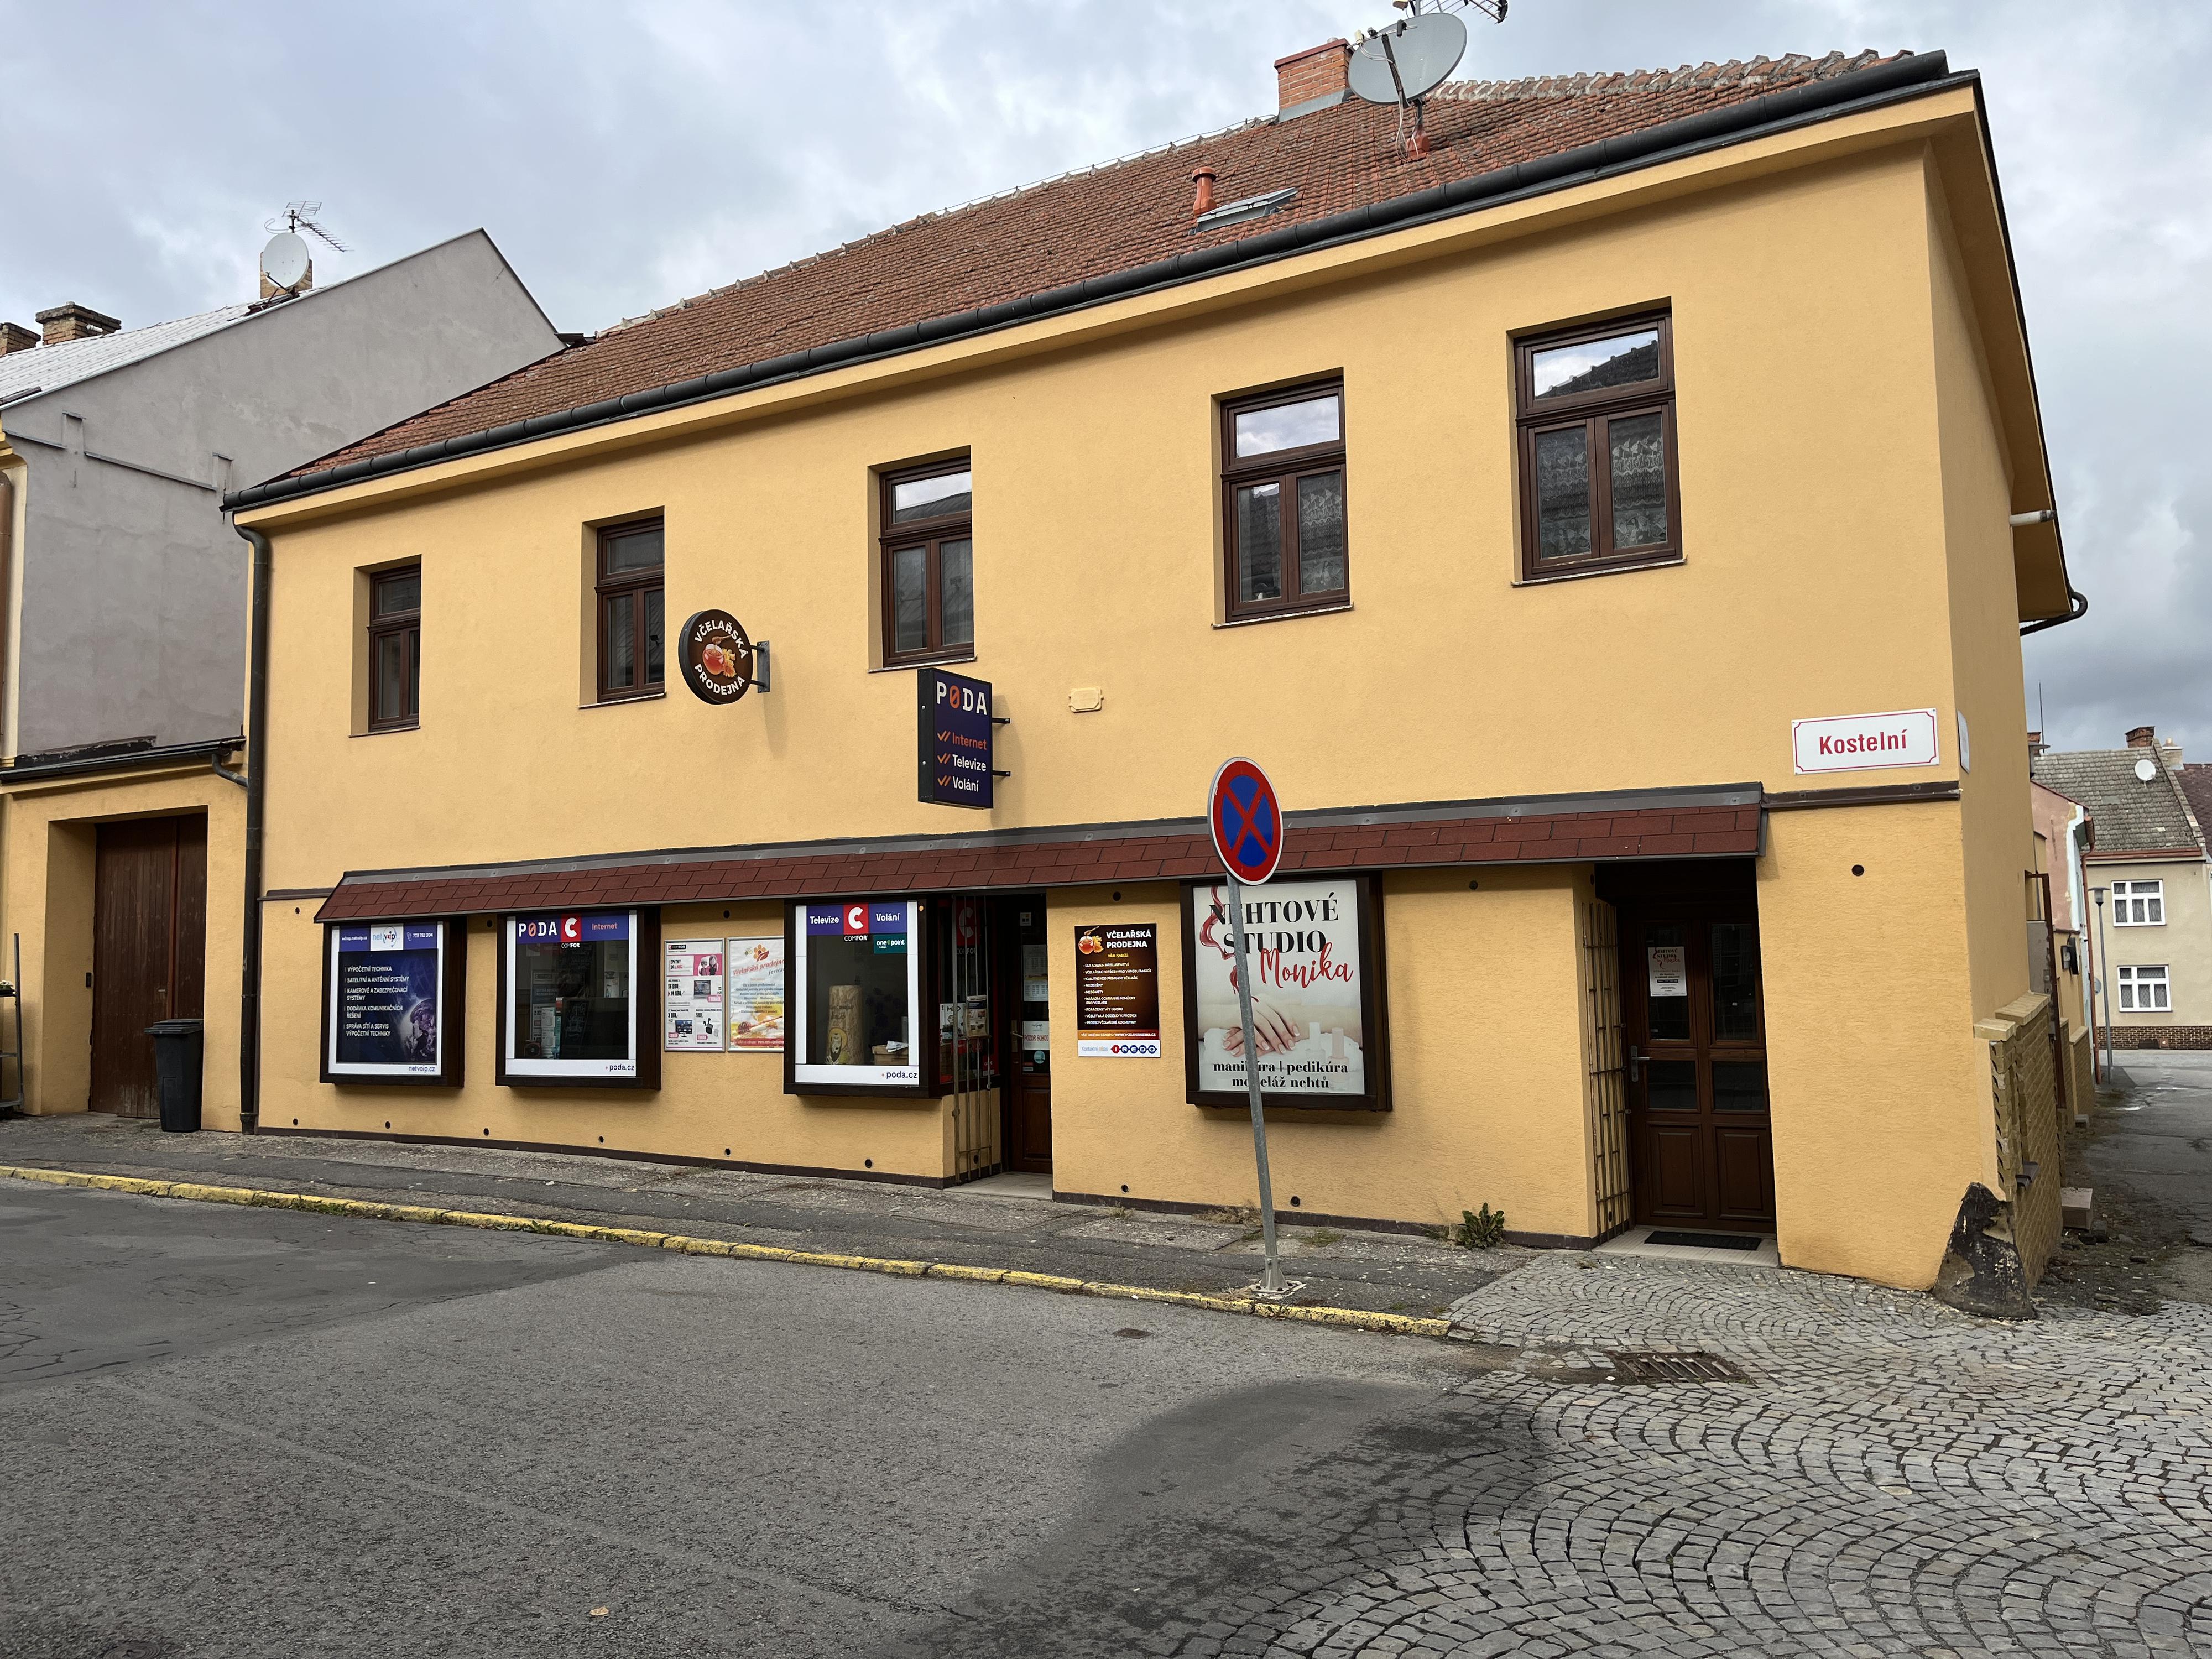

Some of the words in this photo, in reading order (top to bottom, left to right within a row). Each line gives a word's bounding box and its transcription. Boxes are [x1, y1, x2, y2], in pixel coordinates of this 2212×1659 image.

[695, 620, 748, 659] VČELAŘSKÁ
[695, 664, 745, 695] PRODEJNA
[953, 732, 987, 750] Internet
[1819, 729, 1907, 755] Kostelní
[952, 754, 987, 771] Televize
[953, 776, 979, 792] Volání
[1209, 892, 1339, 925] NHTOVÉ
[810, 916, 839, 924] Televize
[875, 912, 900, 922] Volání
[592, 922, 617, 931] Internet
[1106, 929, 1152, 939] VČELAŘSKÁ
[1107, 940, 1147, 948] PRODEJNA
[1260, 942, 1353, 988] Monika
[408, 1065, 435, 1073] netvoip.cz
[886, 1071, 917, 1079] poda.cz
[1287, 1061, 1348, 1075] pedikúra
[1291, 1076, 1329, 1088] nehtů
